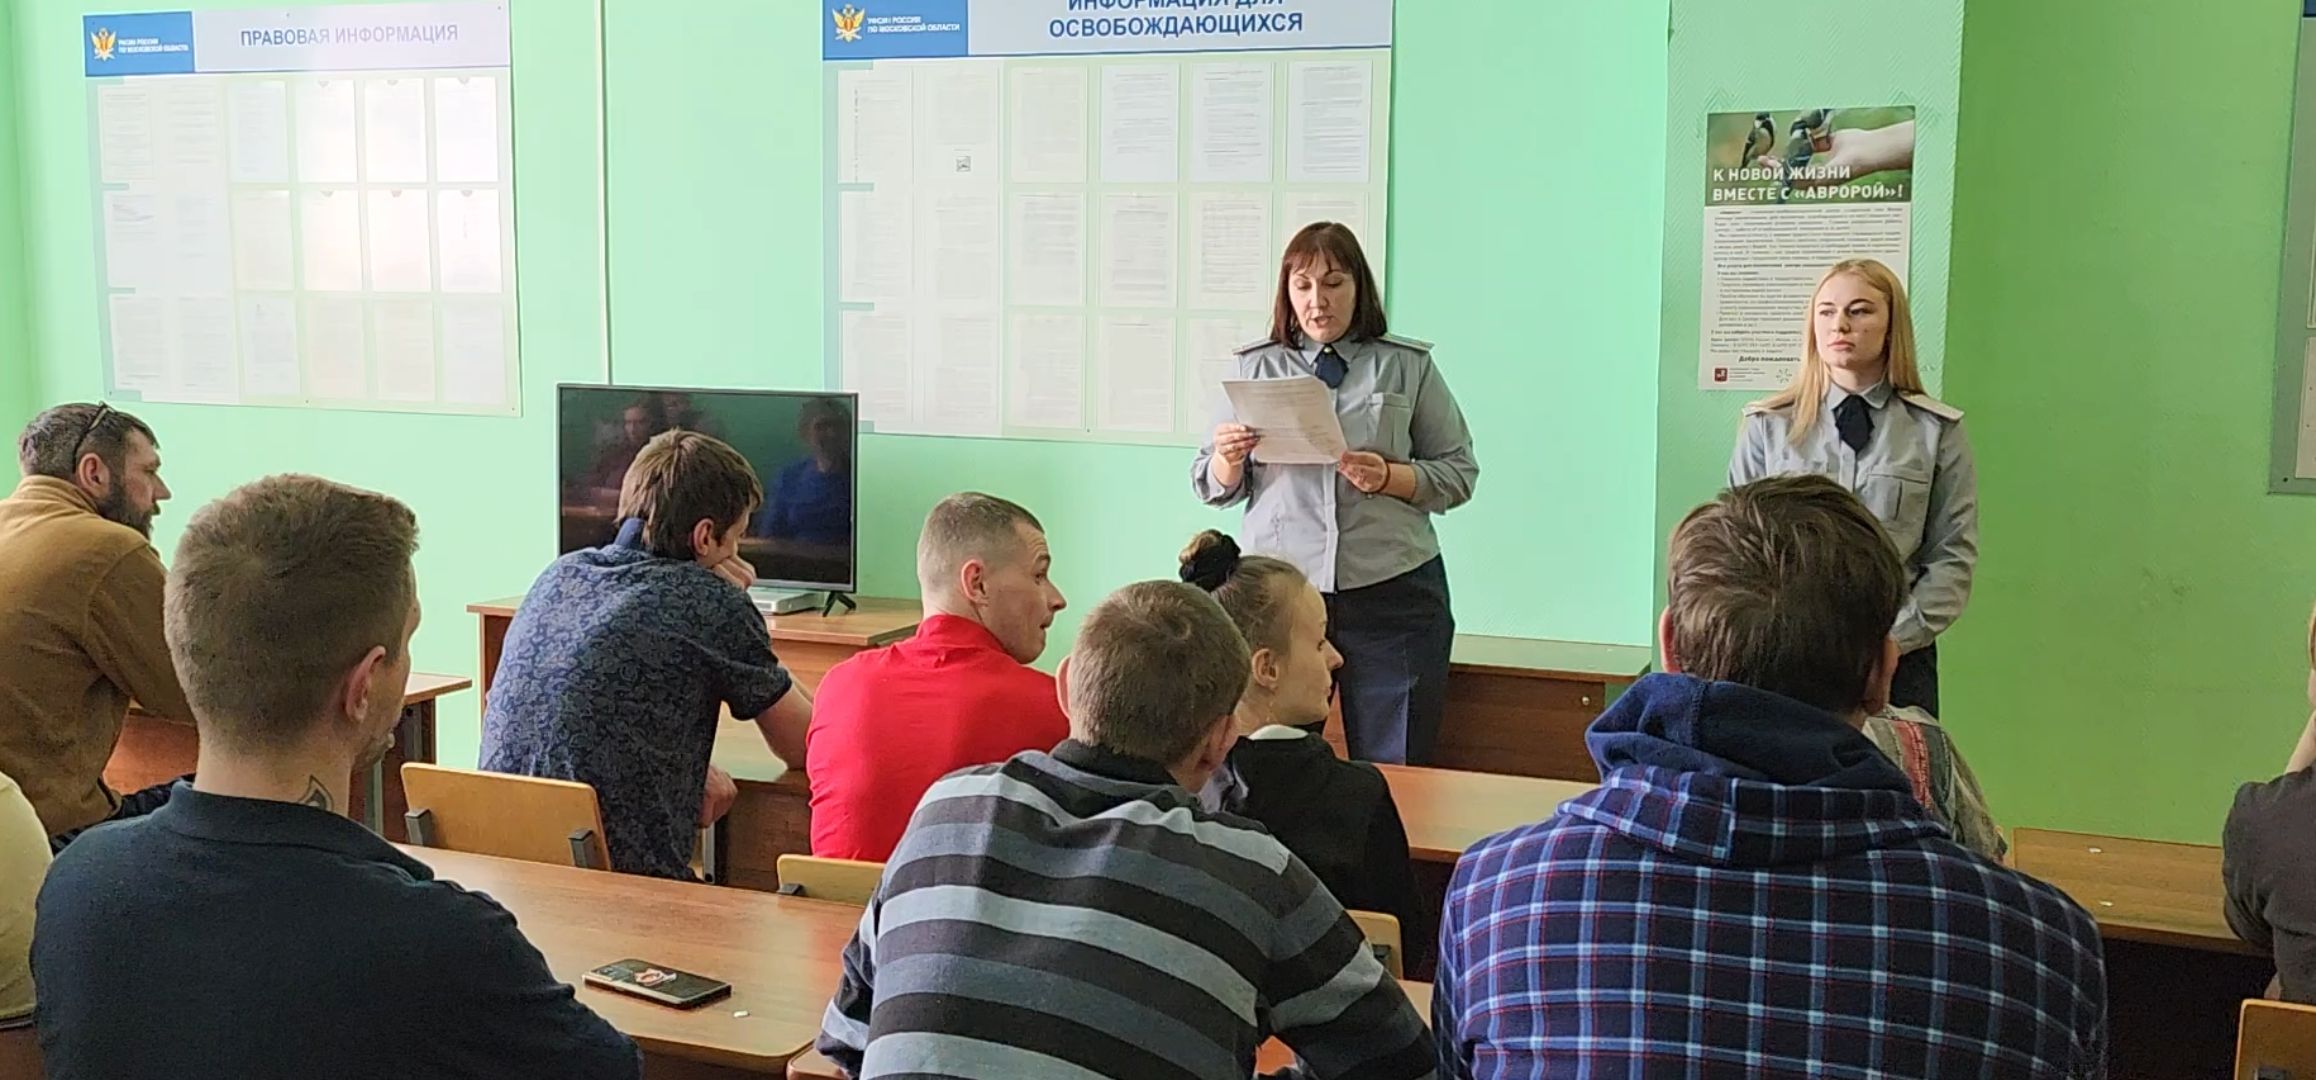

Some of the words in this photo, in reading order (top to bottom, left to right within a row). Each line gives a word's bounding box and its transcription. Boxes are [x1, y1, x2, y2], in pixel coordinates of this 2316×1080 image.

[241, 28, 330, 46] ПРАВОВАЯ
[335, 24, 458, 45] ИНФОРМАЦИЯ
[1049, 12, 1303, 38] ОСВОБОЖДАЮЩИХСЯ
[1713, 169, 1723, 181] К
[1788, 166, 1850, 180] ЖИЗНИ
[1713, 187, 1776, 201] ВМЕСТЕ
[1781, 187, 1790, 200] С
[1795, 182, 1903, 199] «АВРОРОЙ»!
